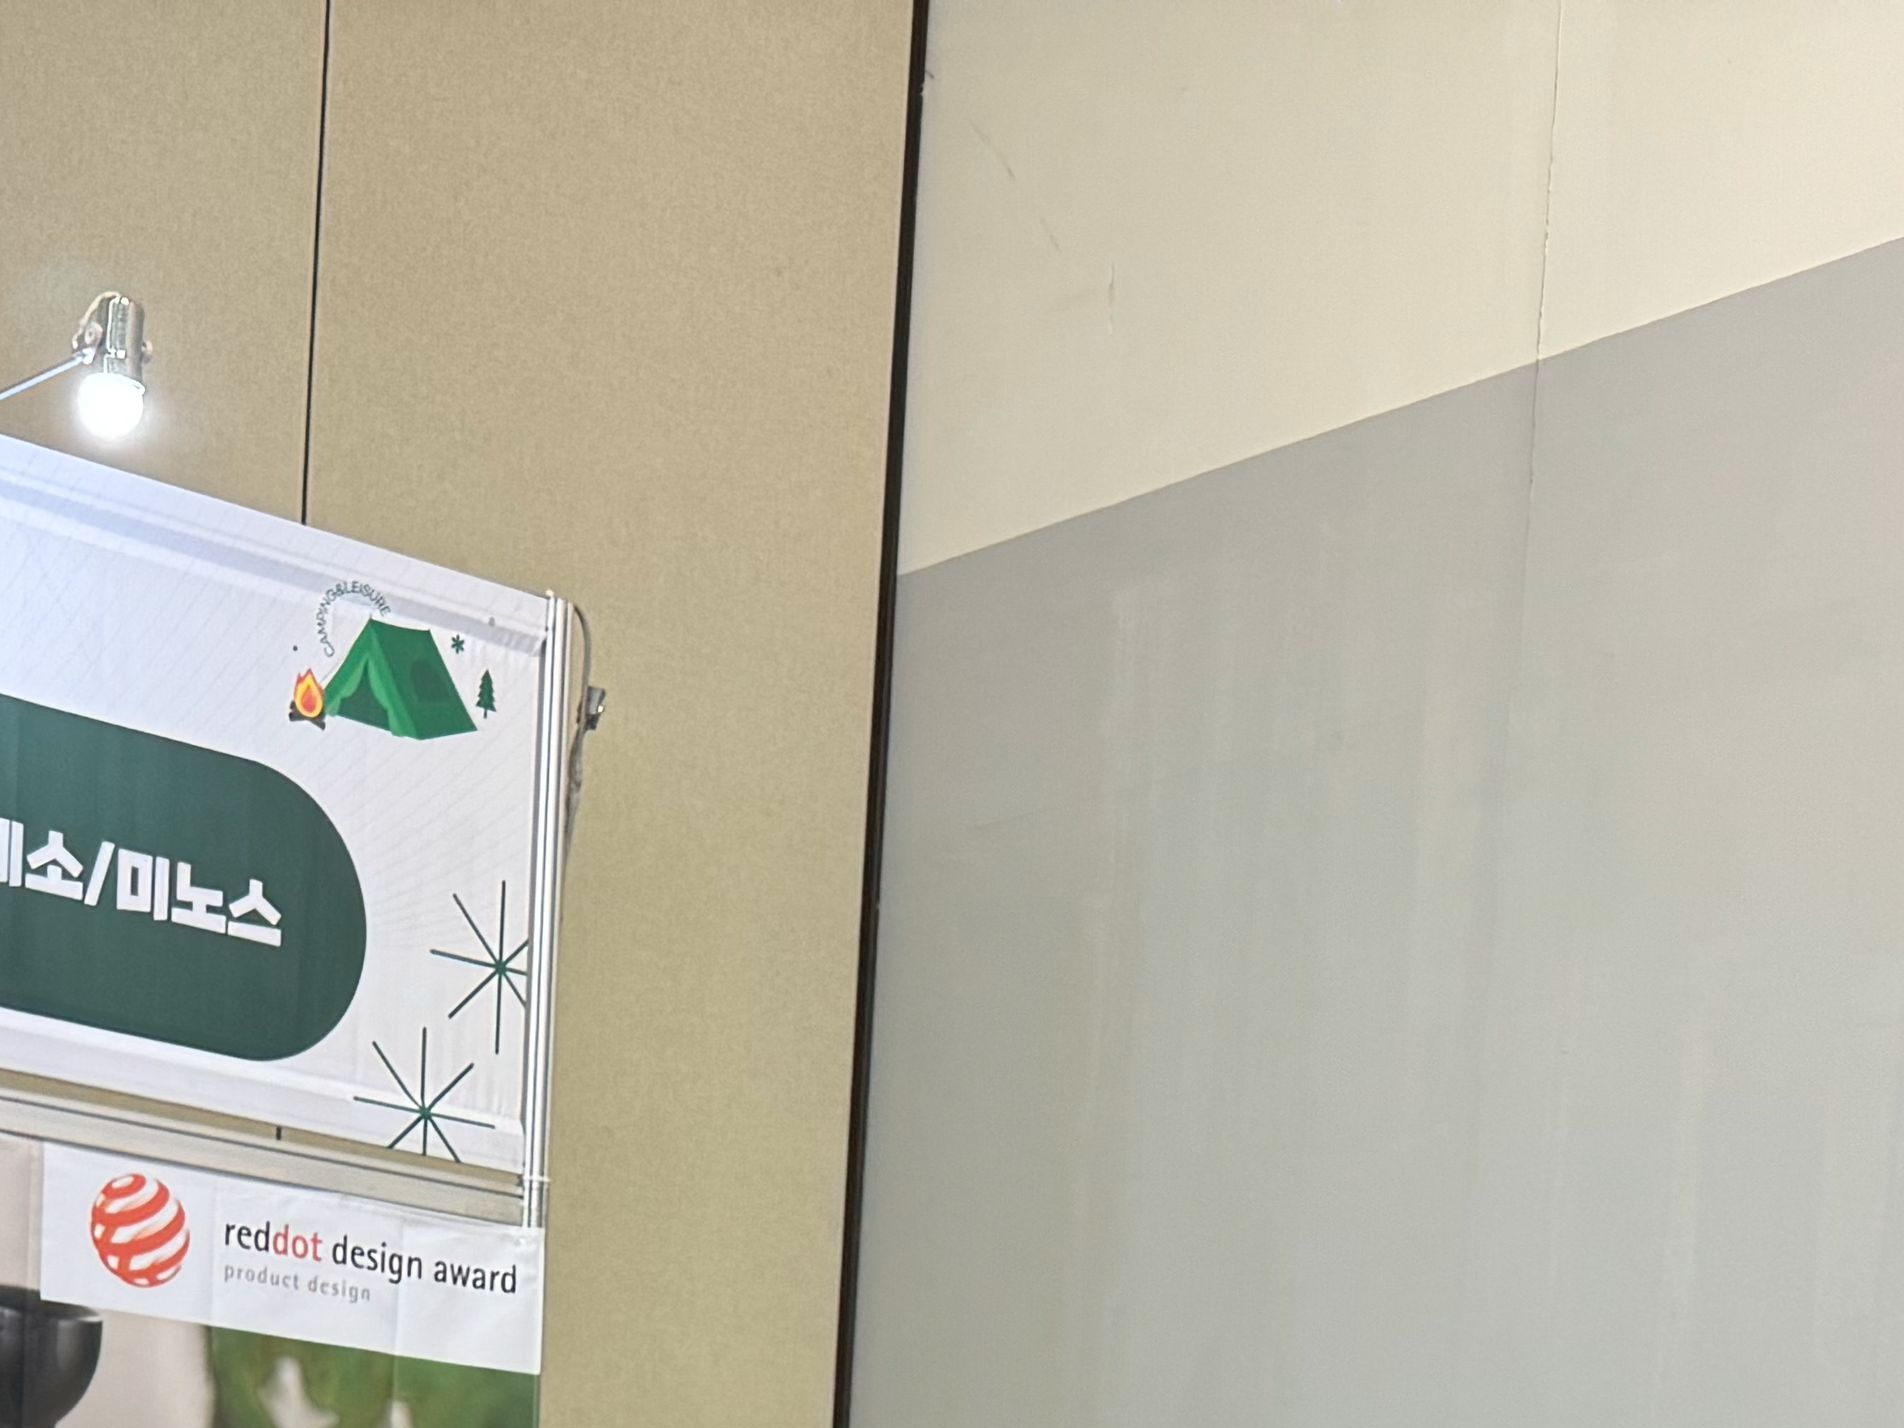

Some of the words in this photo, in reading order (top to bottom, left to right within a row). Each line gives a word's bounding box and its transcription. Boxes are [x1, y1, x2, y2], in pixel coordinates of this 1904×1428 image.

[224, 1220, 323, 1263] reddot
[332, 1235, 423, 1283] design
[433, 1257, 517, 1294] award
[224, 1264, 301, 1291] product
[307, 1277, 372, 1303] design
